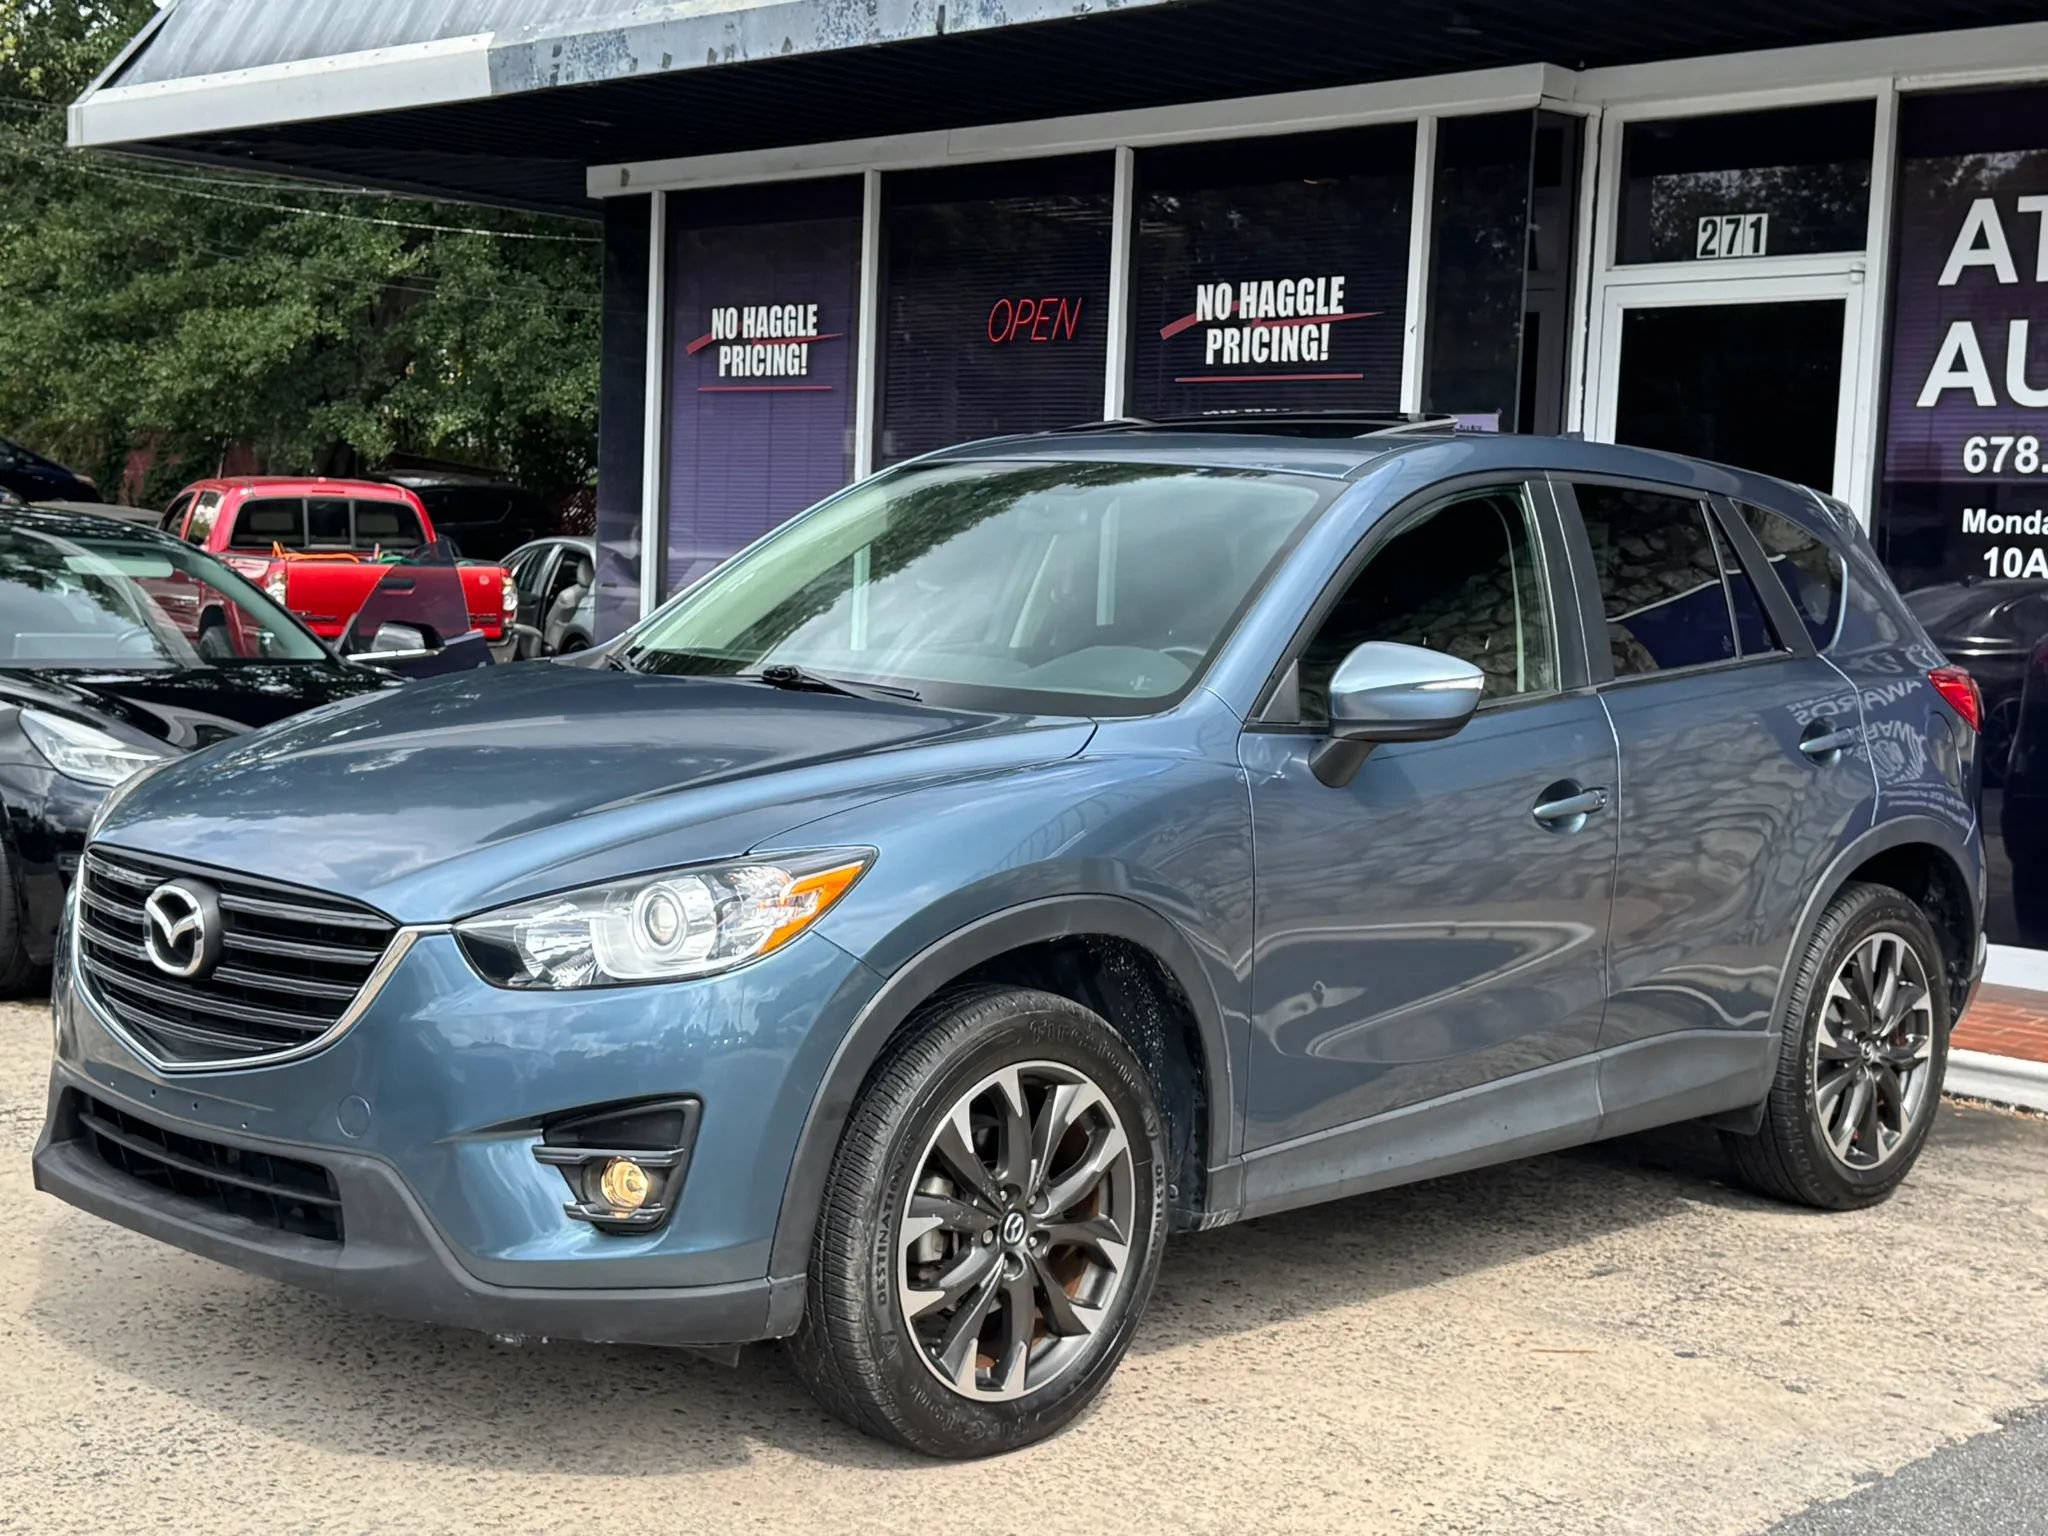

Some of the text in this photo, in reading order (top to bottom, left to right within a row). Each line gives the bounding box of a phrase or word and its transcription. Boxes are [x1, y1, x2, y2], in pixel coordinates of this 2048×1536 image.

[1701, 217, 1763, 256] 271
[988, 297, 1082, 342] OPEN
[1196, 276, 1346, 322] NO HAGGLE
[711, 304, 818, 340] NO HAGGLE
[718, 343, 808, 377] PRICING!
[1205, 323, 1330, 365] PRICING!
[1916, 319, 2048, 408] AU
[1983, 546, 2048, 579] 10A
[876, 1163, 905, 1307] DESTINATION
